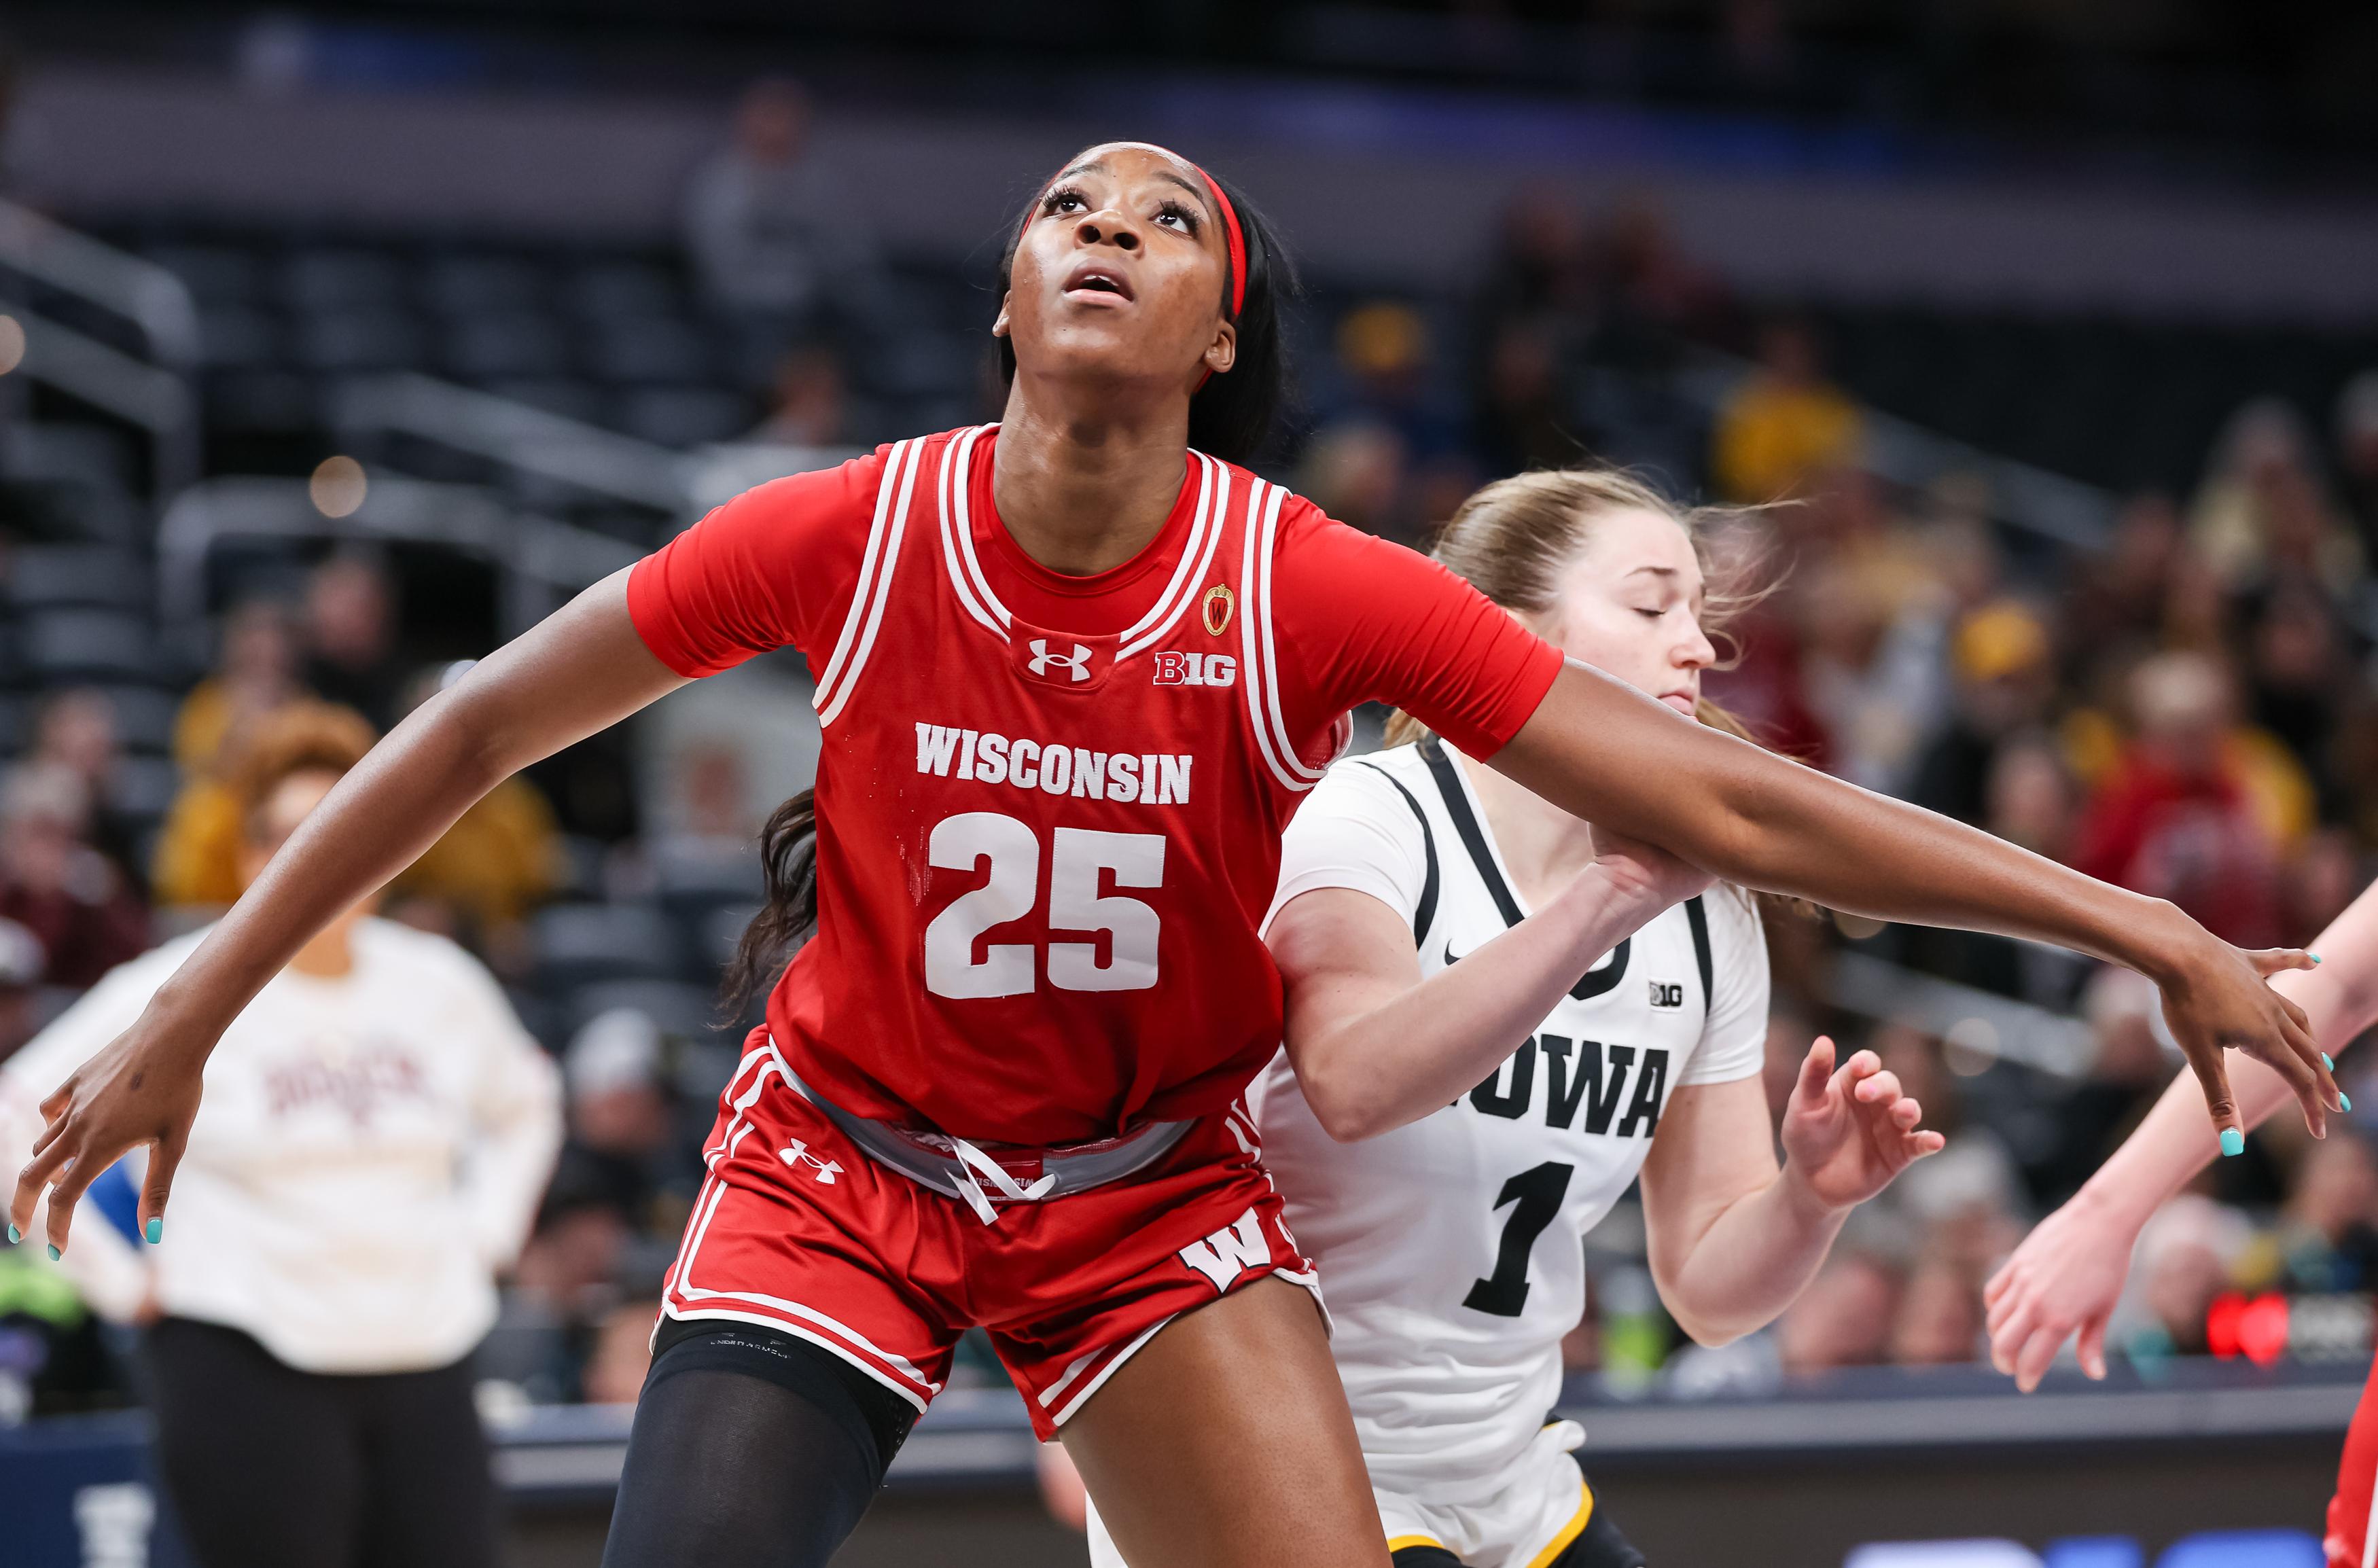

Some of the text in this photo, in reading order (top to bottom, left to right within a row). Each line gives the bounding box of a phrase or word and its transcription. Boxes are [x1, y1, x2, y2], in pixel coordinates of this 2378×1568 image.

[1211, 602, 1226, 624] W
[915, 721, 1192, 805] WISCONSIN
[925, 812, 1166, 999] 25
[1450, 1033, 1669, 1139] OWA
[1177, 1205, 1272, 1294] W
[1461, 1161, 1574, 1317] 1
